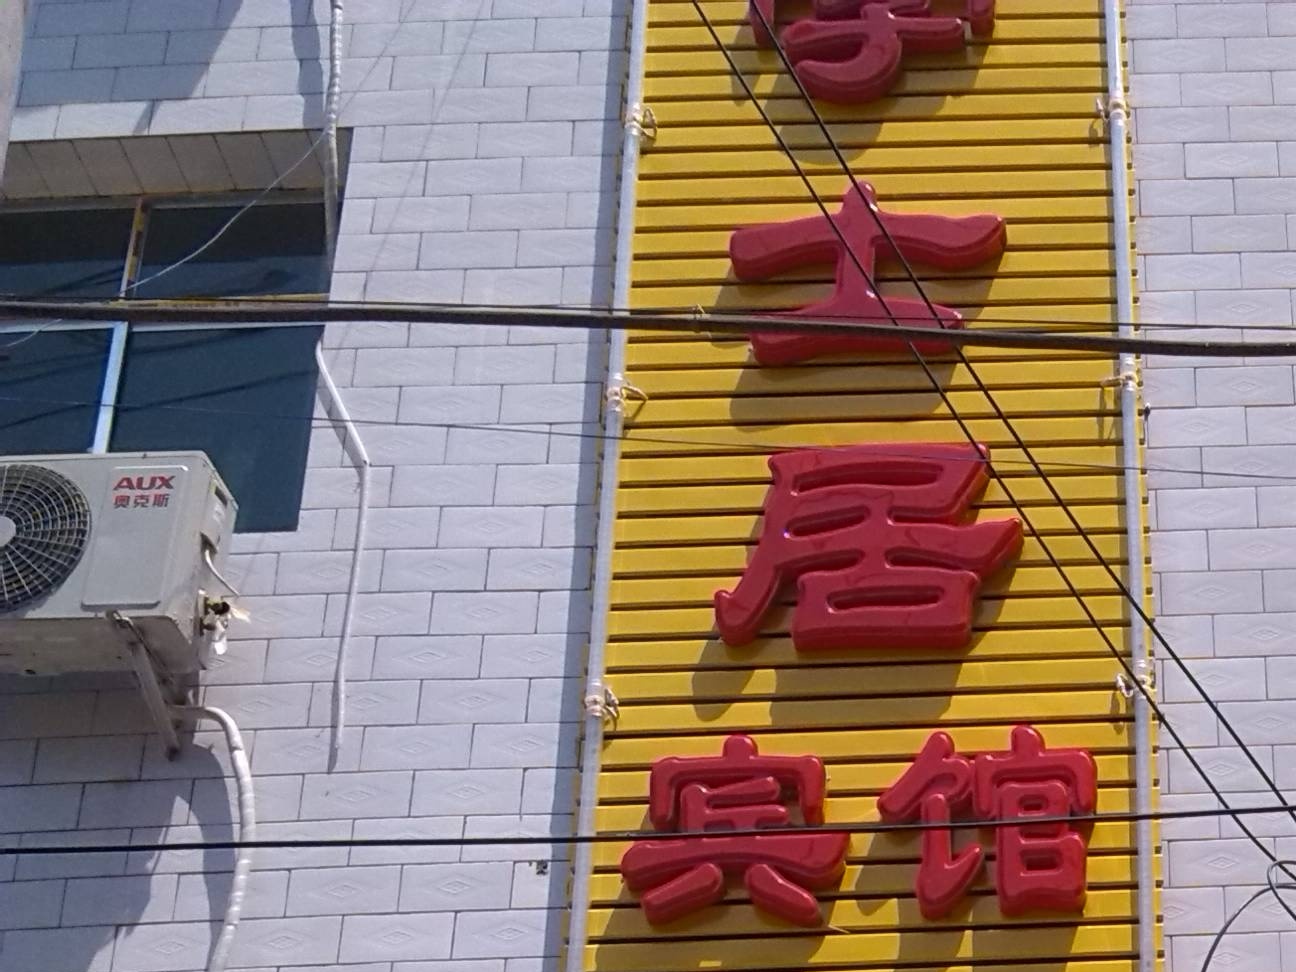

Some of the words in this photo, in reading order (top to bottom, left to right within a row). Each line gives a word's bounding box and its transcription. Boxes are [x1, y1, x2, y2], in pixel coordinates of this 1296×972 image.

[113, 475, 176, 491] AUX
[113, 493, 170, 509] 奥克斯
[620, 724, 1098, 929] 宾馆
